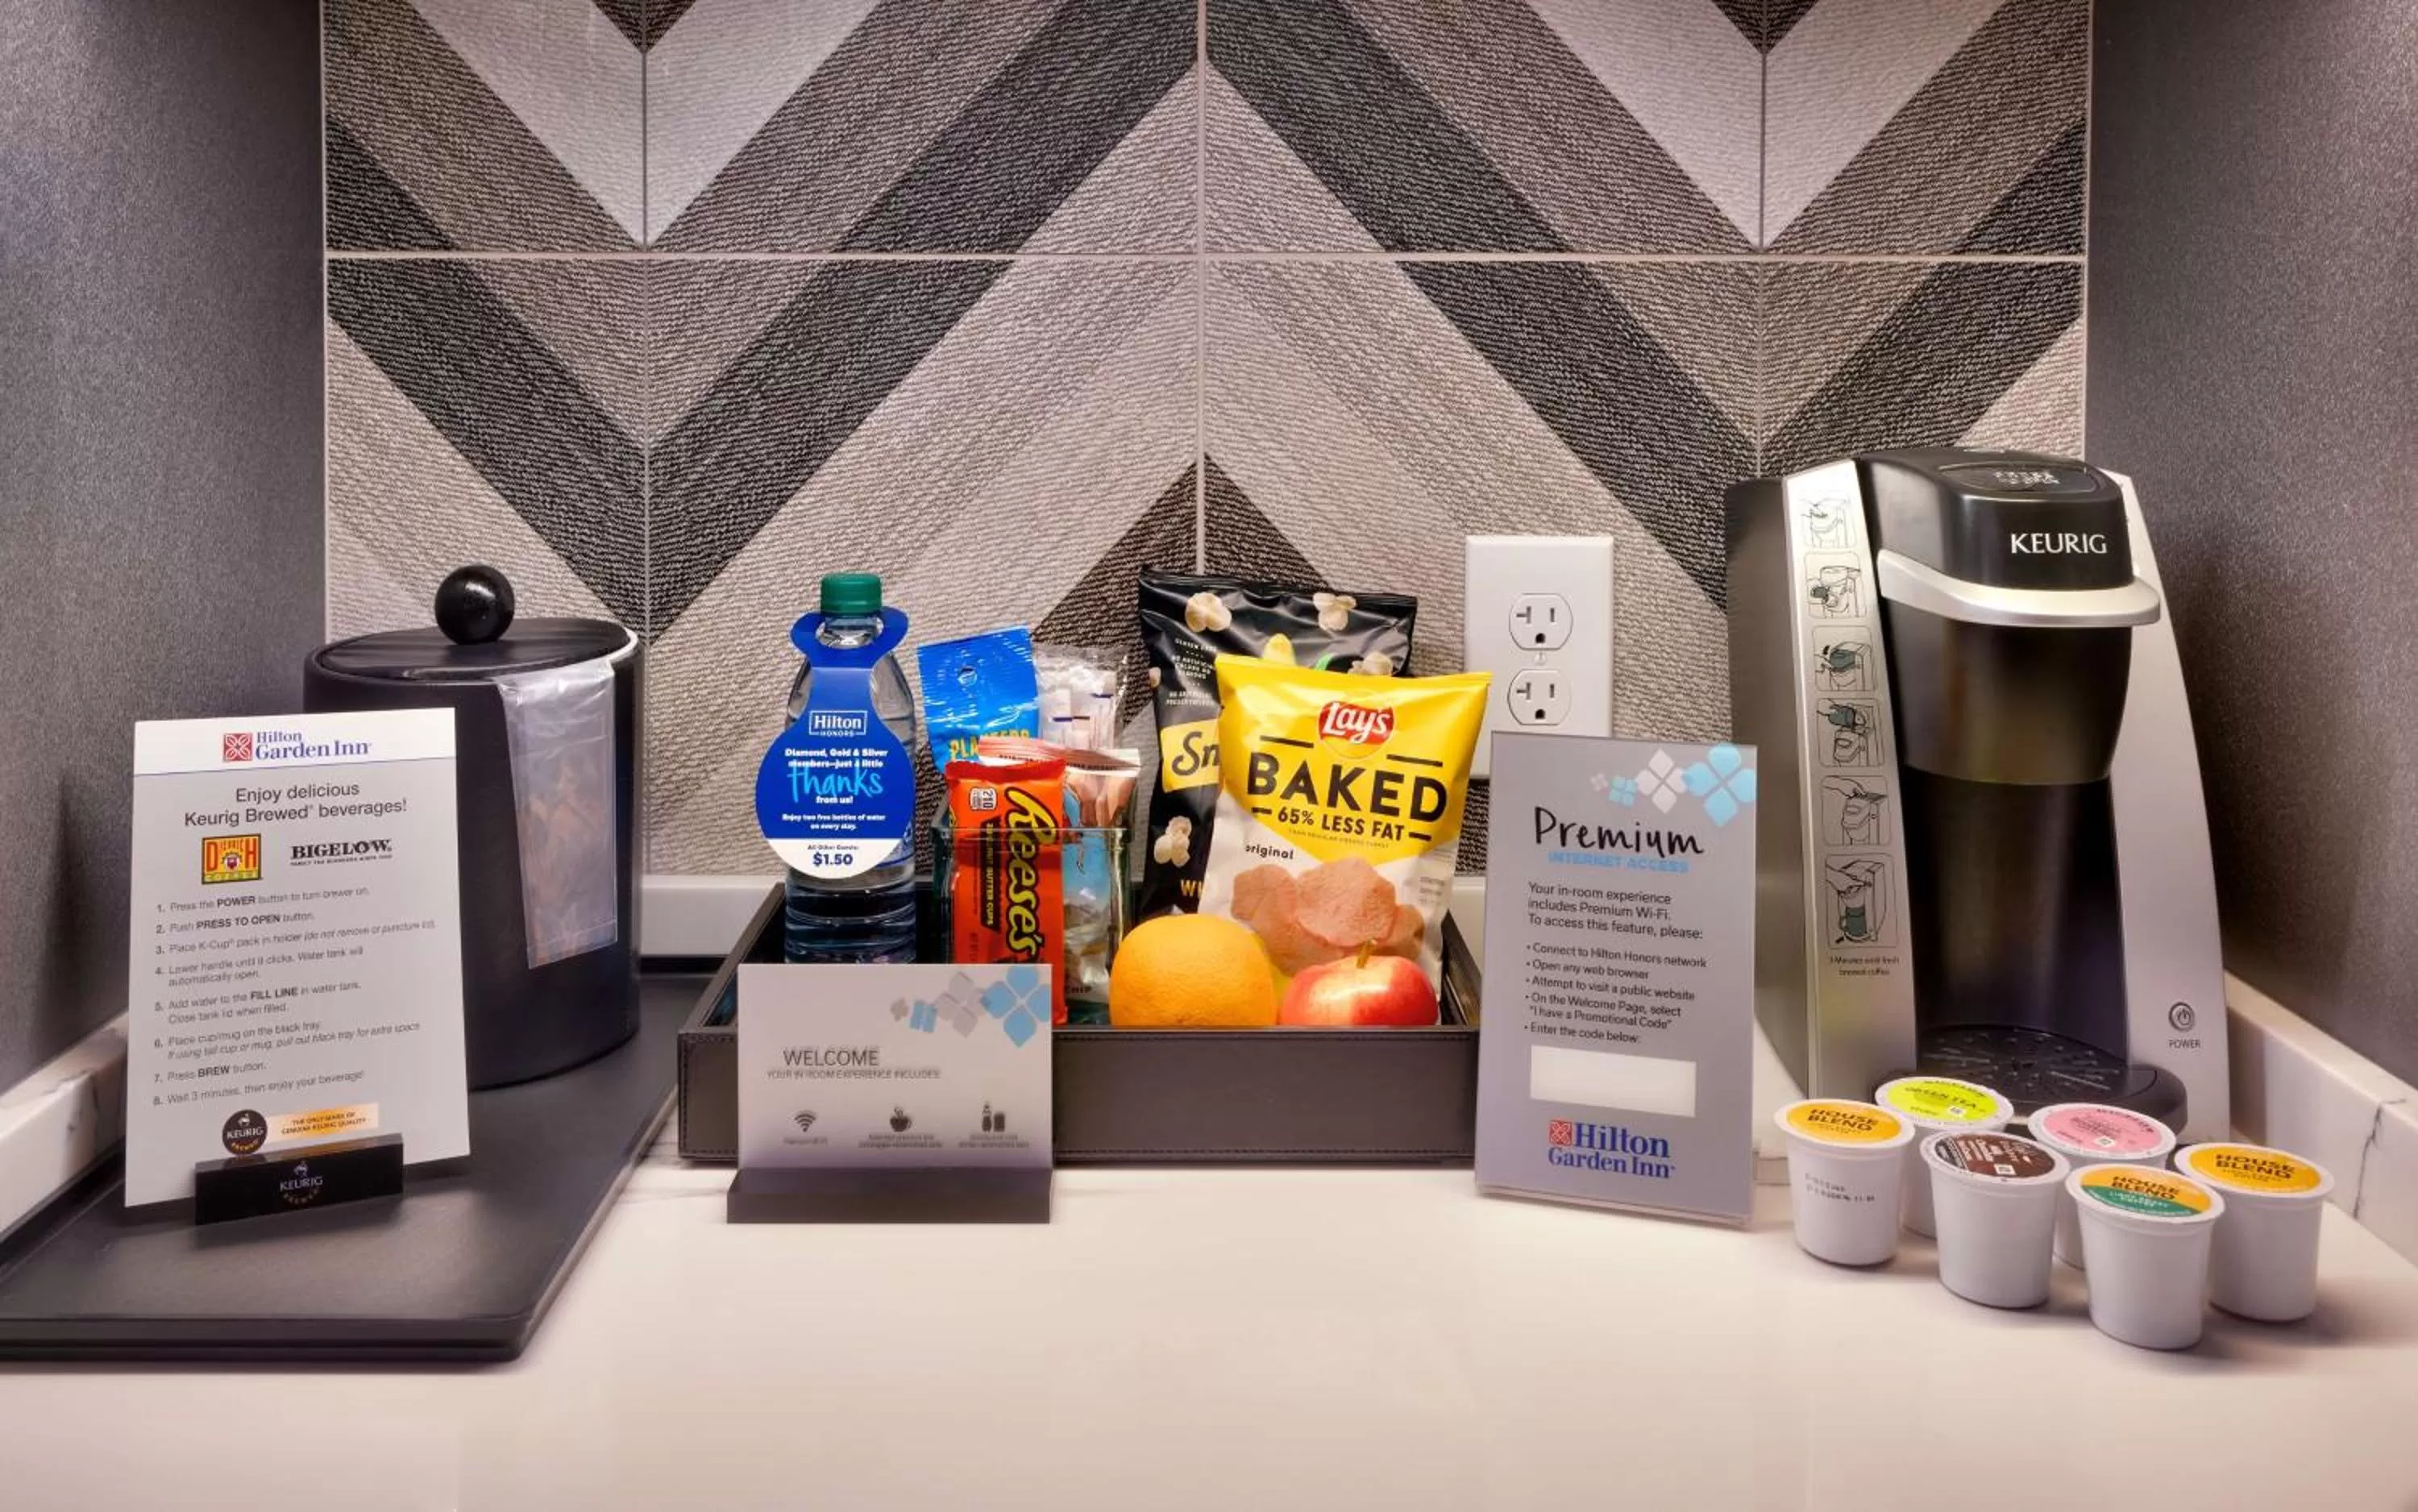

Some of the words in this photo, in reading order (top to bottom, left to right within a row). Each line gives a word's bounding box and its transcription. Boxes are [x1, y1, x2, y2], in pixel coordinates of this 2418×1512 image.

[2011, 533, 2107, 555] KEURIG
[814, 715, 862, 729] Hilton
[1323, 702, 1392, 743] Lay's
[256, 731, 302, 744] Hilton
[256, 742, 330, 761] Garden
[334, 740, 369, 756] Inn
[784, 748, 827, 758] Diamond,
[829, 749, 851, 757] Gold
[862, 748, 888, 756] Silver
[862, 759, 883, 767] little
[236, 787, 281, 804] Enjoy
[287, 783, 360, 800] delicious
[1247, 751, 1448, 823] BAKED
[815, 795, 838, 804] from
[983, 791, 993, 808] 210
[185, 810, 239, 828] Keurig
[318, 799, 407, 818] beverages!
[1278, 806, 1315, 825] 65%
[1321, 813, 1366, 835] LESS
[1372, 820, 1405, 841] FAT
[1534, 806, 1704, 858] Premium
[290, 839, 389, 860] BIGELOW
[812, 851, 854, 867] $1.50
[1548, 851, 1622, 869] INTERNET
[1627, 857, 1689, 873] ACCESS
[217, 895, 256, 908] POWER
[1528, 881, 1555, 895] Your
[1558, 884, 1603, 899] in-room
[1606, 890, 1671, 905] experience
[1528, 898, 1577, 913] includes
[1580, 901, 1633, 916] Premium
[196, 918, 232, 930] PRESS
[235, 916, 249, 927] TO
[251, 914, 280, 926] OPEN
[1528, 912, 1542, 925] To
[1544, 917, 1584, 929] access
[1587, 918, 1610, 931] this
[1611, 920, 1657, 937] feature,
[1660, 926, 1703, 940] please:
[1532, 942, 1576, 956] Connect
[1577, 947, 1589, 957] to
[1590, 947, 1621, 961] Hilton
[1623, 950, 1662, 964] Honors
[1664, 956, 1707, 968] network
[1532, 958, 1561, 973] Open
[1563, 963, 1581, 975] any
[1583, 963, 1605, 975] web
[1606, 966, 1650, 979] browser
[1531, 975, 1573, 990] Attempt
[1576, 980, 1587, 991] to
[1589, 982, 1610, 993] visit
[1611, 985, 1618, 993] a
[1619, 984, 1651, 998] public
[1654, 988, 1695, 1000] website
[1531, 992, 1547, 1004] On
[1549, 993, 1565, 1006] the
[1568, 995, 1616, 1010] Welcome
[1618, 1000, 1647, 1014] Page,
[1650, 1005, 1682, 1017] select
[1539, 1007, 1563, 1019] have
[1566, 1011, 1572, 1020] a
[1574, 1009, 1637, 1027] Promotional
[1531, 1021, 1557, 1035] Enter
[1560, 1024, 1577, 1037] the
[1578, 1028, 1605, 1040] code
[2168, 1038, 2201, 1049] POWER
[783, 1049, 879, 1066] WELCOME
[197, 1065, 230, 1078] BREW
[1807, 1115, 1873, 1131] BLEND
[1810, 1108, 1879, 1126] HOUSE
[226, 1127, 264, 1139] KEURIG
[1573, 1121, 1671, 1158] Hilton
[1548, 1147, 1627, 1174] Garden
[1631, 1156, 1671, 1179] Inn
[2216, 1153, 2295, 1173] HOUSE
[2216, 1160, 2292, 1179] BLEND
[280, 1176, 323, 1191] KEURIG
[2111, 1182, 2175, 1200] BLEND
[2112, 1176, 2180, 1195] HOUSE
